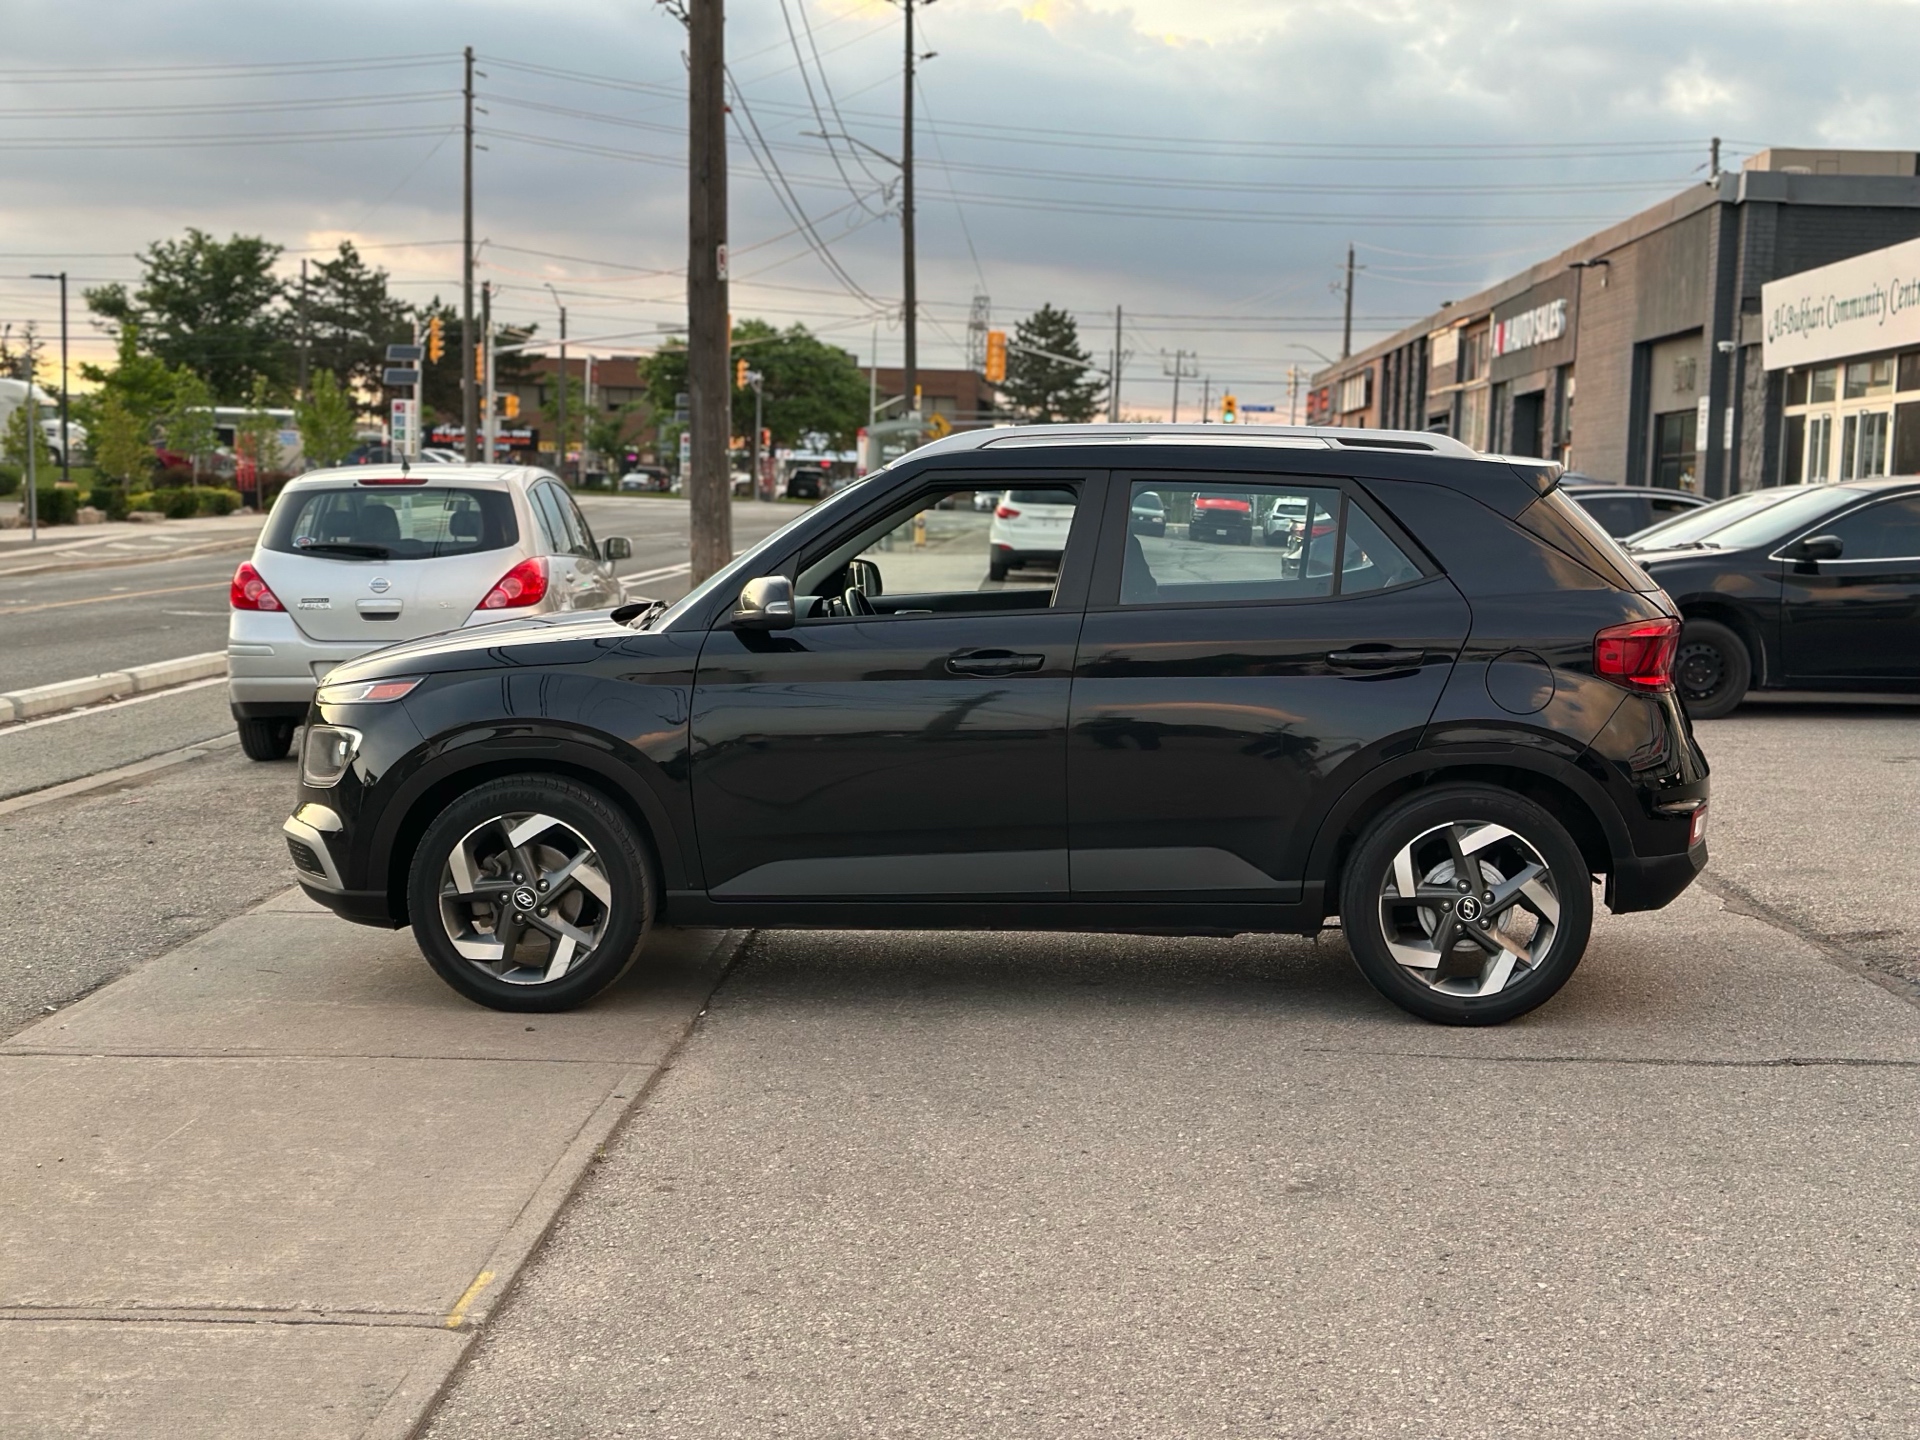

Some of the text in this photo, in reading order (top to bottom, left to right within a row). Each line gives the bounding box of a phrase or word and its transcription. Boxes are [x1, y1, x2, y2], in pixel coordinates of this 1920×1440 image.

[1511, 309, 1535, 351] AUTO
[1533, 298, 1567, 345] SALES
[1827, 282, 1887, 329] Community
[297, 602, 332, 610] VERSA
